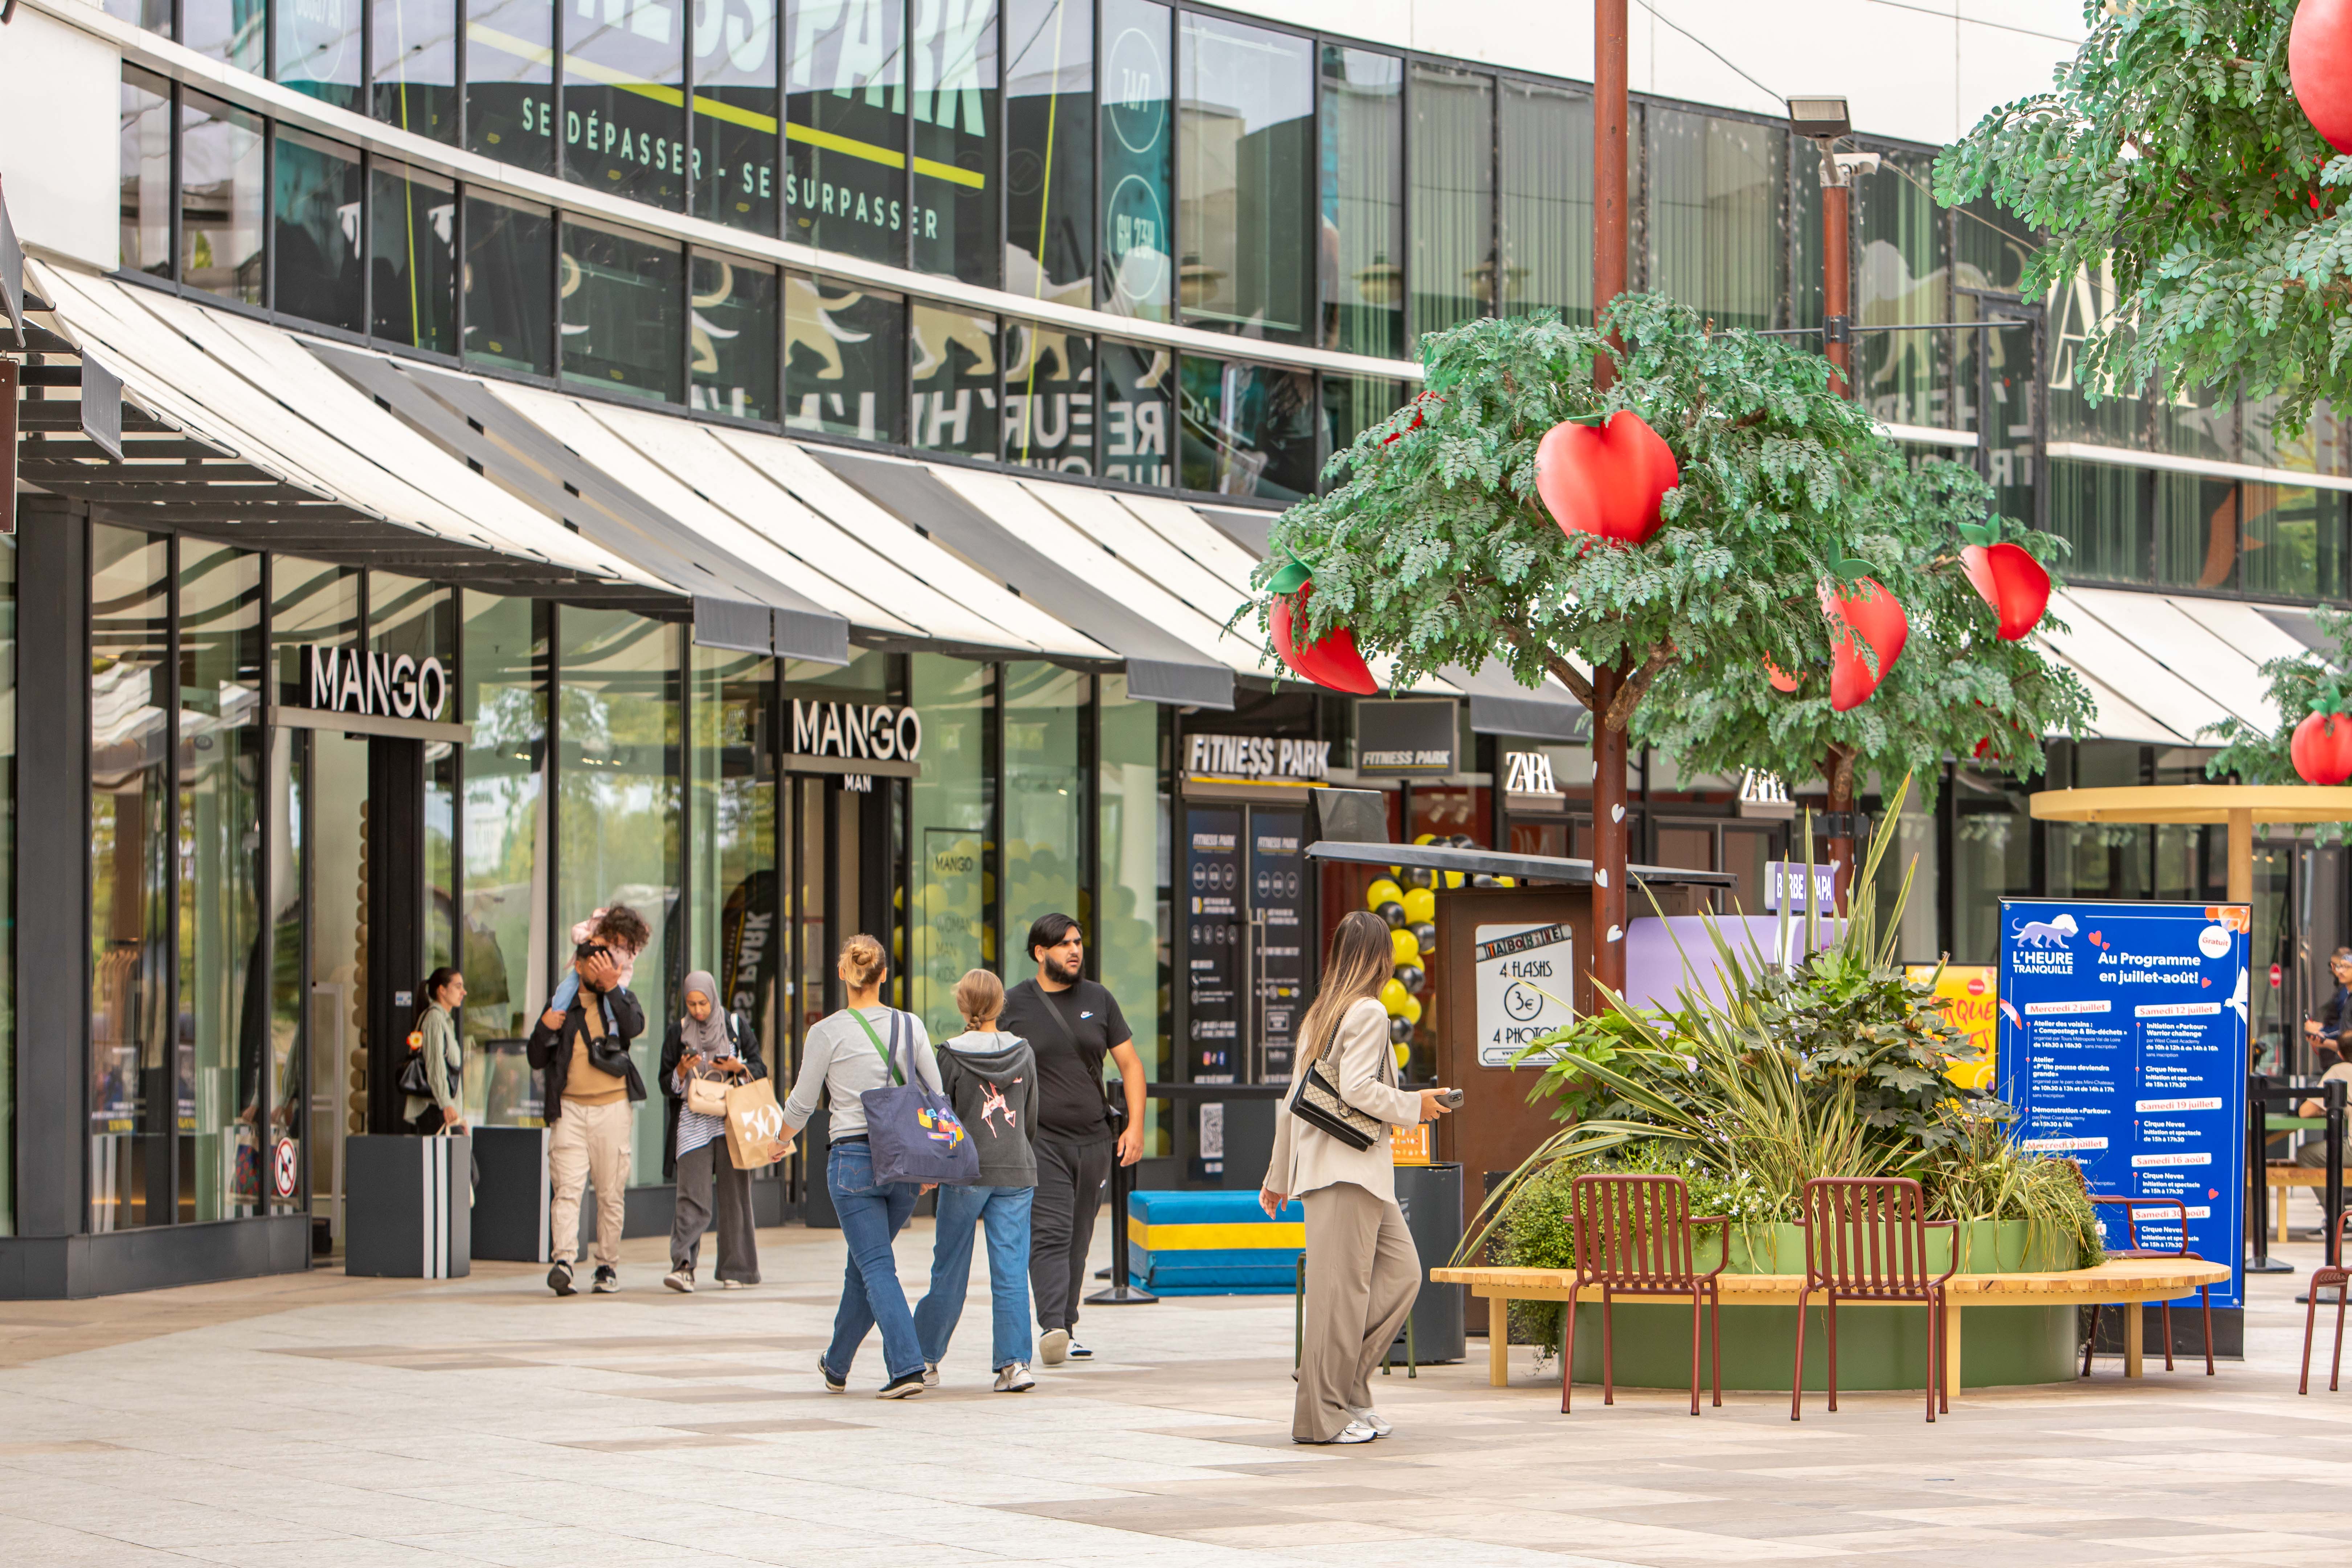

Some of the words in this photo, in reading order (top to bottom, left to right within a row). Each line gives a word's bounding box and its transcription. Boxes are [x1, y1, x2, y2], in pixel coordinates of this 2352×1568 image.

[792, 0, 985, 137] PARK
[523, 97, 551, 137] SE
[568, 109, 701, 180] DÉPASSER
[743, 162, 770, 198] SE
[786, 174, 937, 239] SURPASSER
[311, 644, 445, 721] MANGO
[793, 698, 921, 761] MANGO
[1190, 734, 1275, 776] FITNESS
[1279, 739, 1331, 777] PARK
[1362, 750, 1414, 765] FITNESS
[1415, 750, 1450, 765] PARK
[1505, 752, 1557, 794] ZARA
[844, 774, 871, 792] MAN
[935, 856, 973, 872] MANGO
[1777, 873, 1804, 900] BRBE
[2202, 937, 2228, 946] Gratuit
[2013, 951, 2073, 965] L'HEURE
[2098, 953, 2116, 965] Au
[2120, 953, 2201, 967] Programme
[1500, 961, 1507, 978] 4
[1512, 961, 1552, 977] FLASHS
[2014, 965, 2073, 974] TRANQUILLE
[2099, 973, 2116, 982] en
[2118, 971, 2198, 984] juillet-août!
[2080, 1004, 2105, 1013] juillet
[2188, 1006, 2213, 1016] juillet
[1493, 1028, 1500, 1044] 4
[2189, 1101, 2214, 1110] juillet
[2078, 1141, 2102, 1150] juillet
